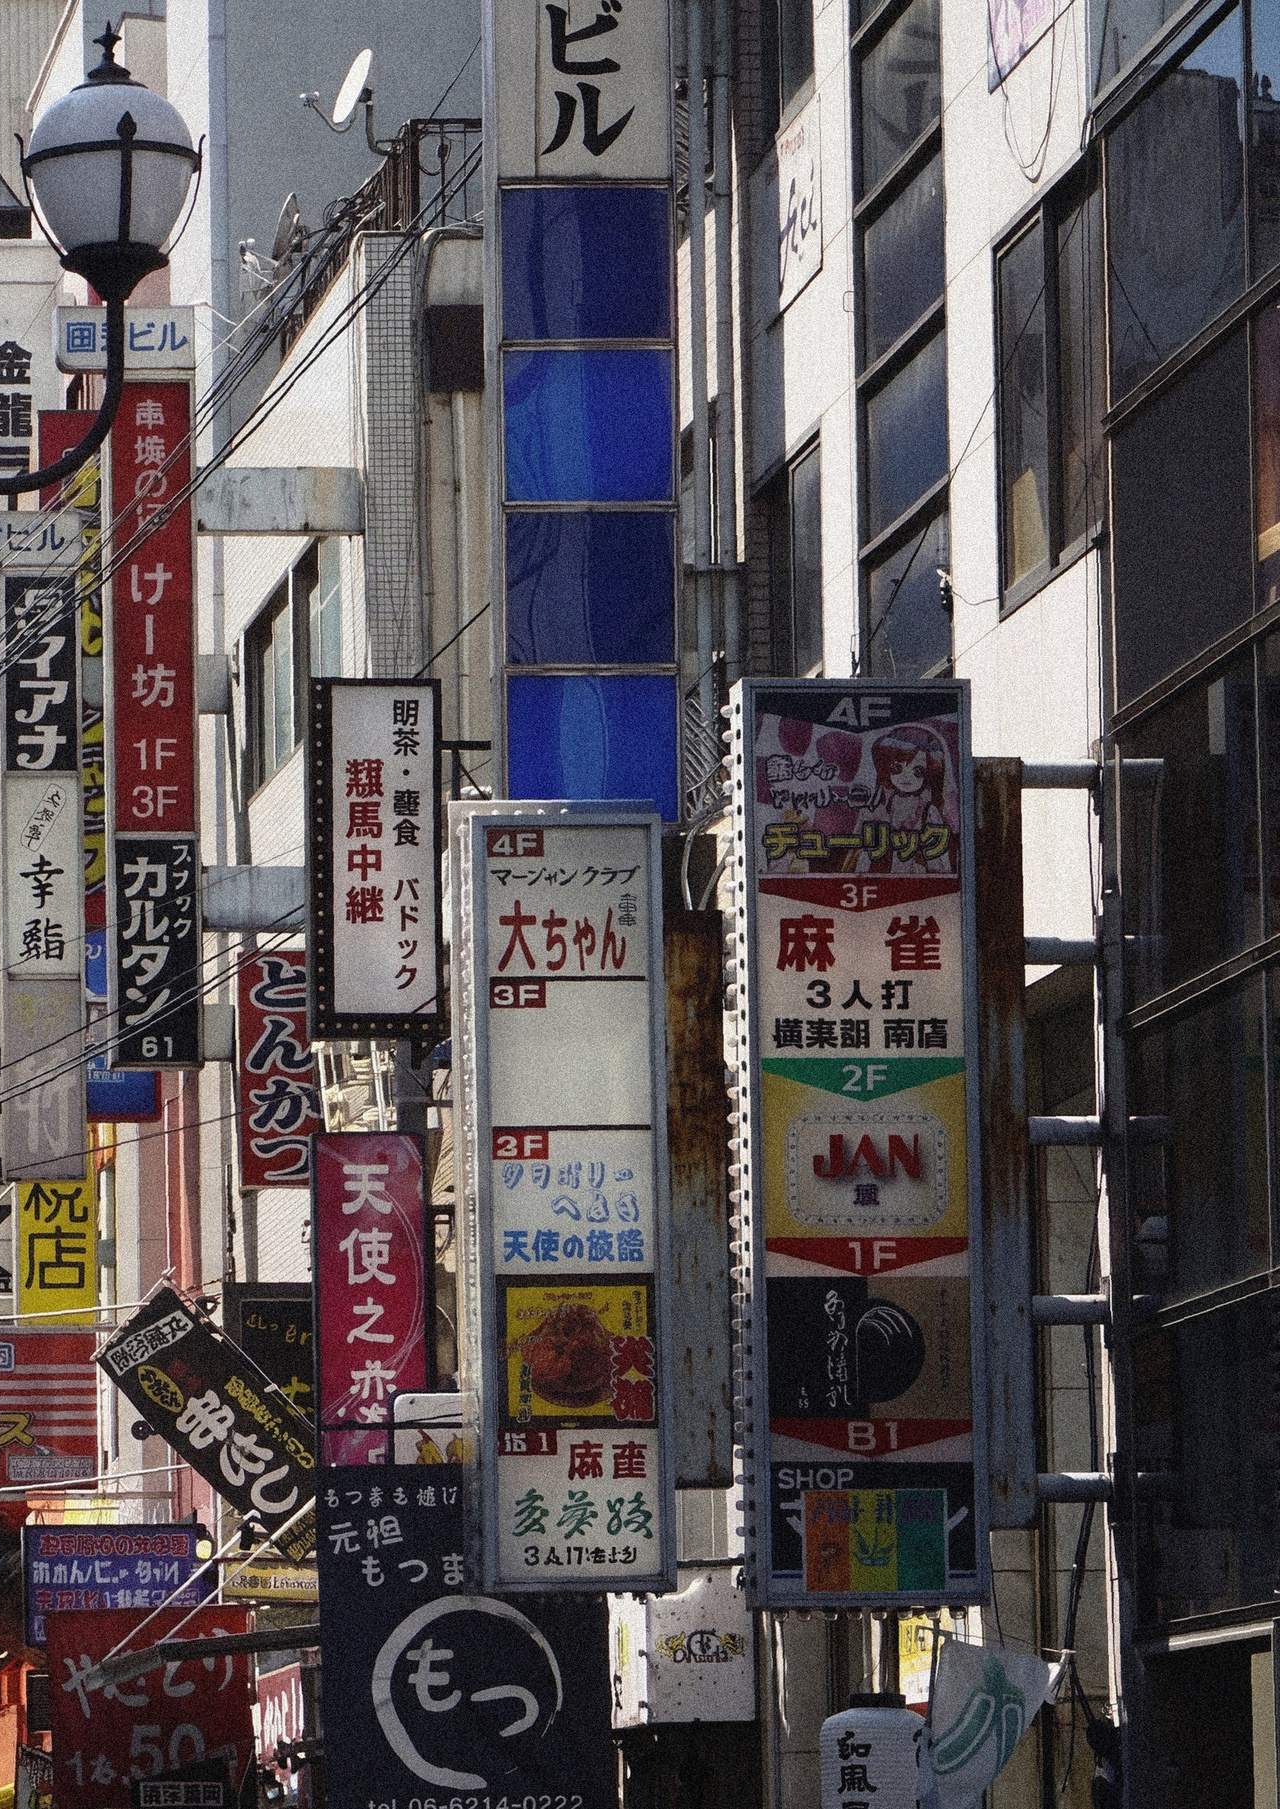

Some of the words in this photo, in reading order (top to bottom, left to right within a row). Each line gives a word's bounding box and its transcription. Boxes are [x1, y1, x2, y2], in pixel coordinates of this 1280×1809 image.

[540, 0, 635, 157] ビル
[131, 563, 177, 708] けー坊
[133, 738, 176, 771] 1F
[131, 785, 178, 818] 3F
[492, 833, 539, 856] 4F
[20, 854, 65, 961] 幸鮨
[839, 883, 879, 909] 3F
[498, 899, 627, 972] 大ちゃん
[776, 915, 943, 972] 麻雀
[493, 984, 541, 1006] 3F
[806, 980, 913, 1009] 3人打
[246, 955, 317, 1181] とんかつ
[841, 1064, 888, 1092] 2F
[495, 1134, 547, 1157] 2F
[812, 1133, 920, 1180] JAN
[847, 1241, 897, 1269] 1F
[846, 1420, 901, 1451] B1
[777, 1468, 856, 1490] SHOP
[406, 1637, 541, 1738] もつ
[836, 1729, 880, 1809] 和風
